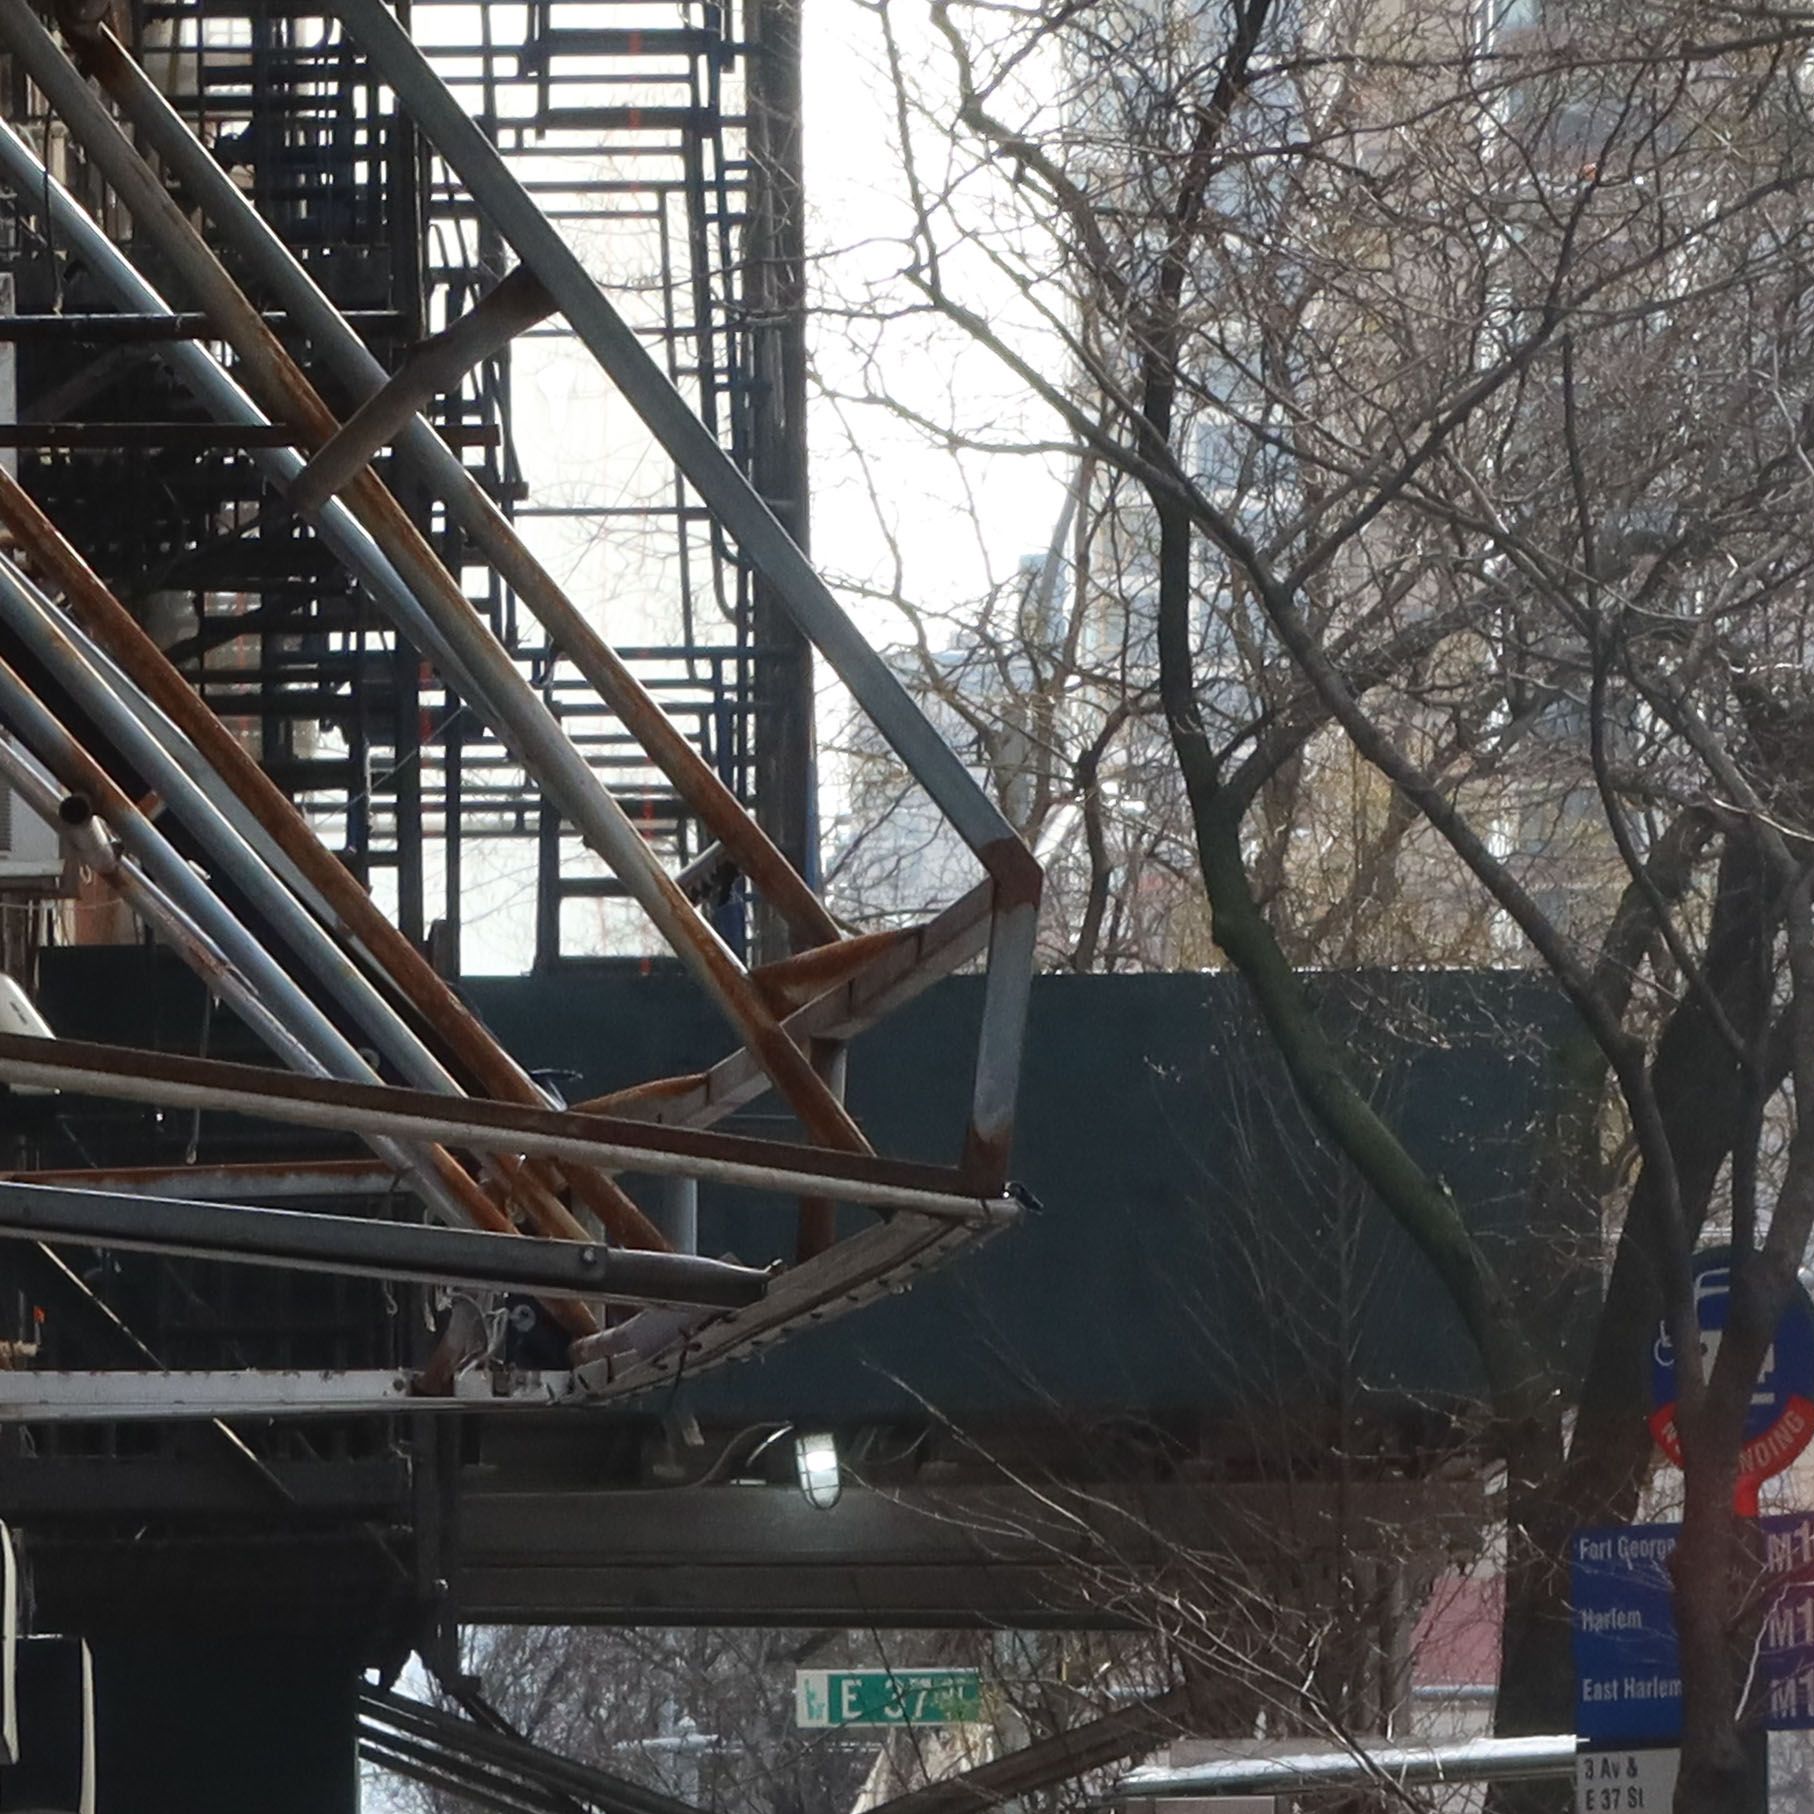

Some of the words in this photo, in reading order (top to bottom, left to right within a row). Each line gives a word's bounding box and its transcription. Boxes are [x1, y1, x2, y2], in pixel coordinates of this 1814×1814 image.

[1581, 1607, 1642, 1633] Harlem
[841, 1679, 863, 1719] E
[1583, 1679, 1618, 1702] East
[1623, 1676, 1682, 1698] Harlem
[1583, 1759, 1594, 1780] 3
[1600, 1757, 1619, 1779] Av
[1586, 1789, 1595, 1811] E
[1600, 1788, 1621, 1811] 37
[1627, 1786, 1644, 1809] St
